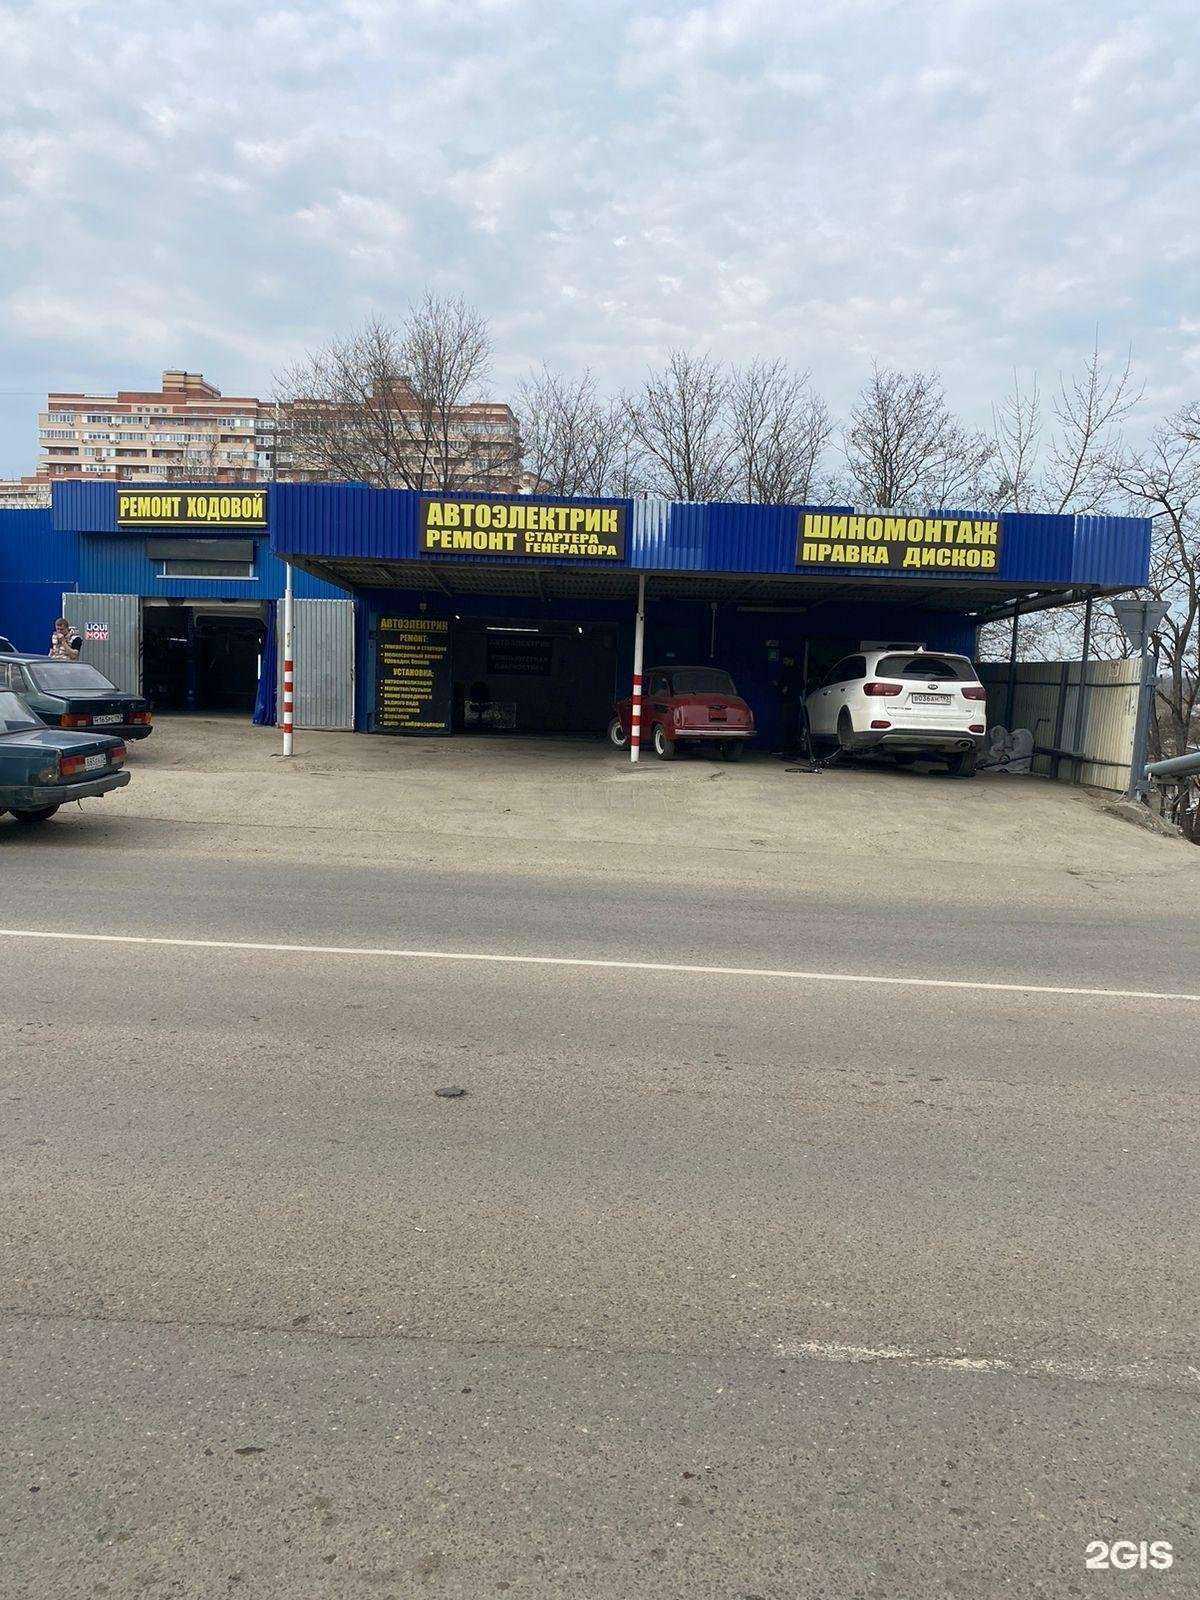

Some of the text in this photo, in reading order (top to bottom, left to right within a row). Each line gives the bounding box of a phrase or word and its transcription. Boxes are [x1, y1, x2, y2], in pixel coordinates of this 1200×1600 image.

[119, 493, 263, 520] РЕМОНТ ХОДОВОЙ
[426, 502, 618, 533] АВТОЭЛЕКТРИК
[426, 529, 599, 551] РЕМОНТ СТАРТЕРА
[803, 514, 999, 545] ШИНОМОНТАЖ
[525, 542, 617, 556] ГЕНЕРАТОРА
[802, 543, 996, 568] ПРАВКА ДИСКОВ
[380, 618, 448, 631] АВТОЭЛЕКТРИК
